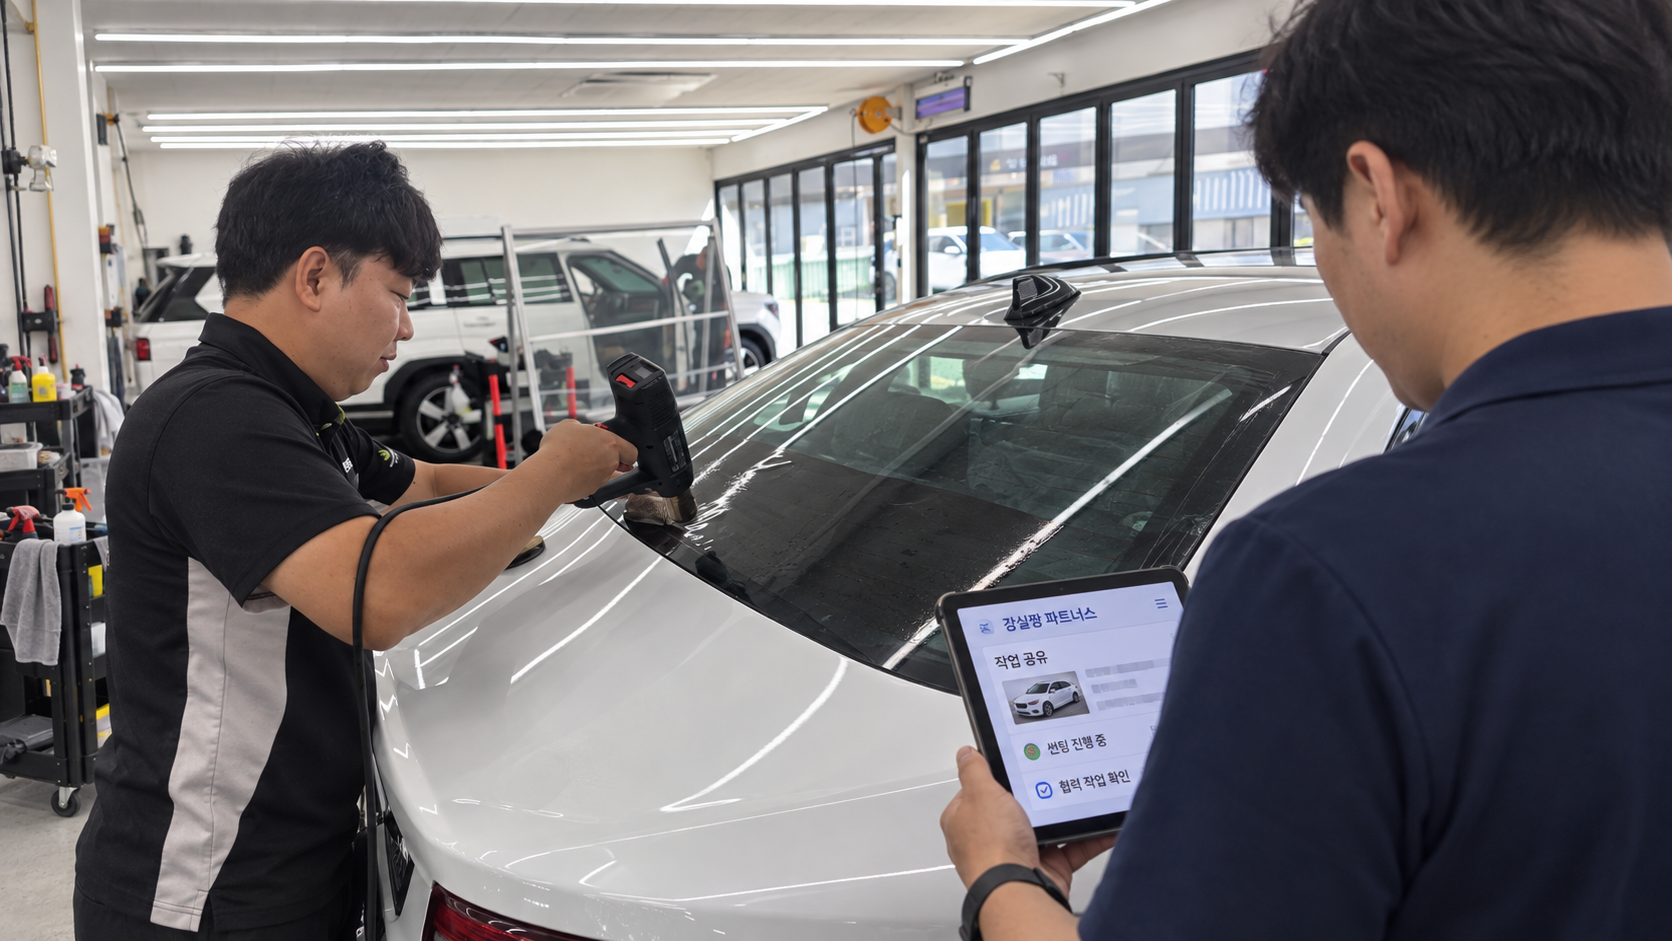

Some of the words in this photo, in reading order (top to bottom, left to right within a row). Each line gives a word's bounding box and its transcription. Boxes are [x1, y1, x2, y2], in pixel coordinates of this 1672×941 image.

[1002, 613, 1043, 632] 강실짱
[1044, 607, 1098, 625] 파트너스
[994, 654, 1021, 670] 작업
[1023, 650, 1048, 666] 공유
[1047, 739, 1070, 756] 썬팅
[1071, 735, 1093, 751] 진행
[1095, 733, 1107, 747] 중
[1059, 777, 1083, 794] 협력
[1083, 773, 1107, 789] 작업
[1107, 769, 1131, 785] 확인
